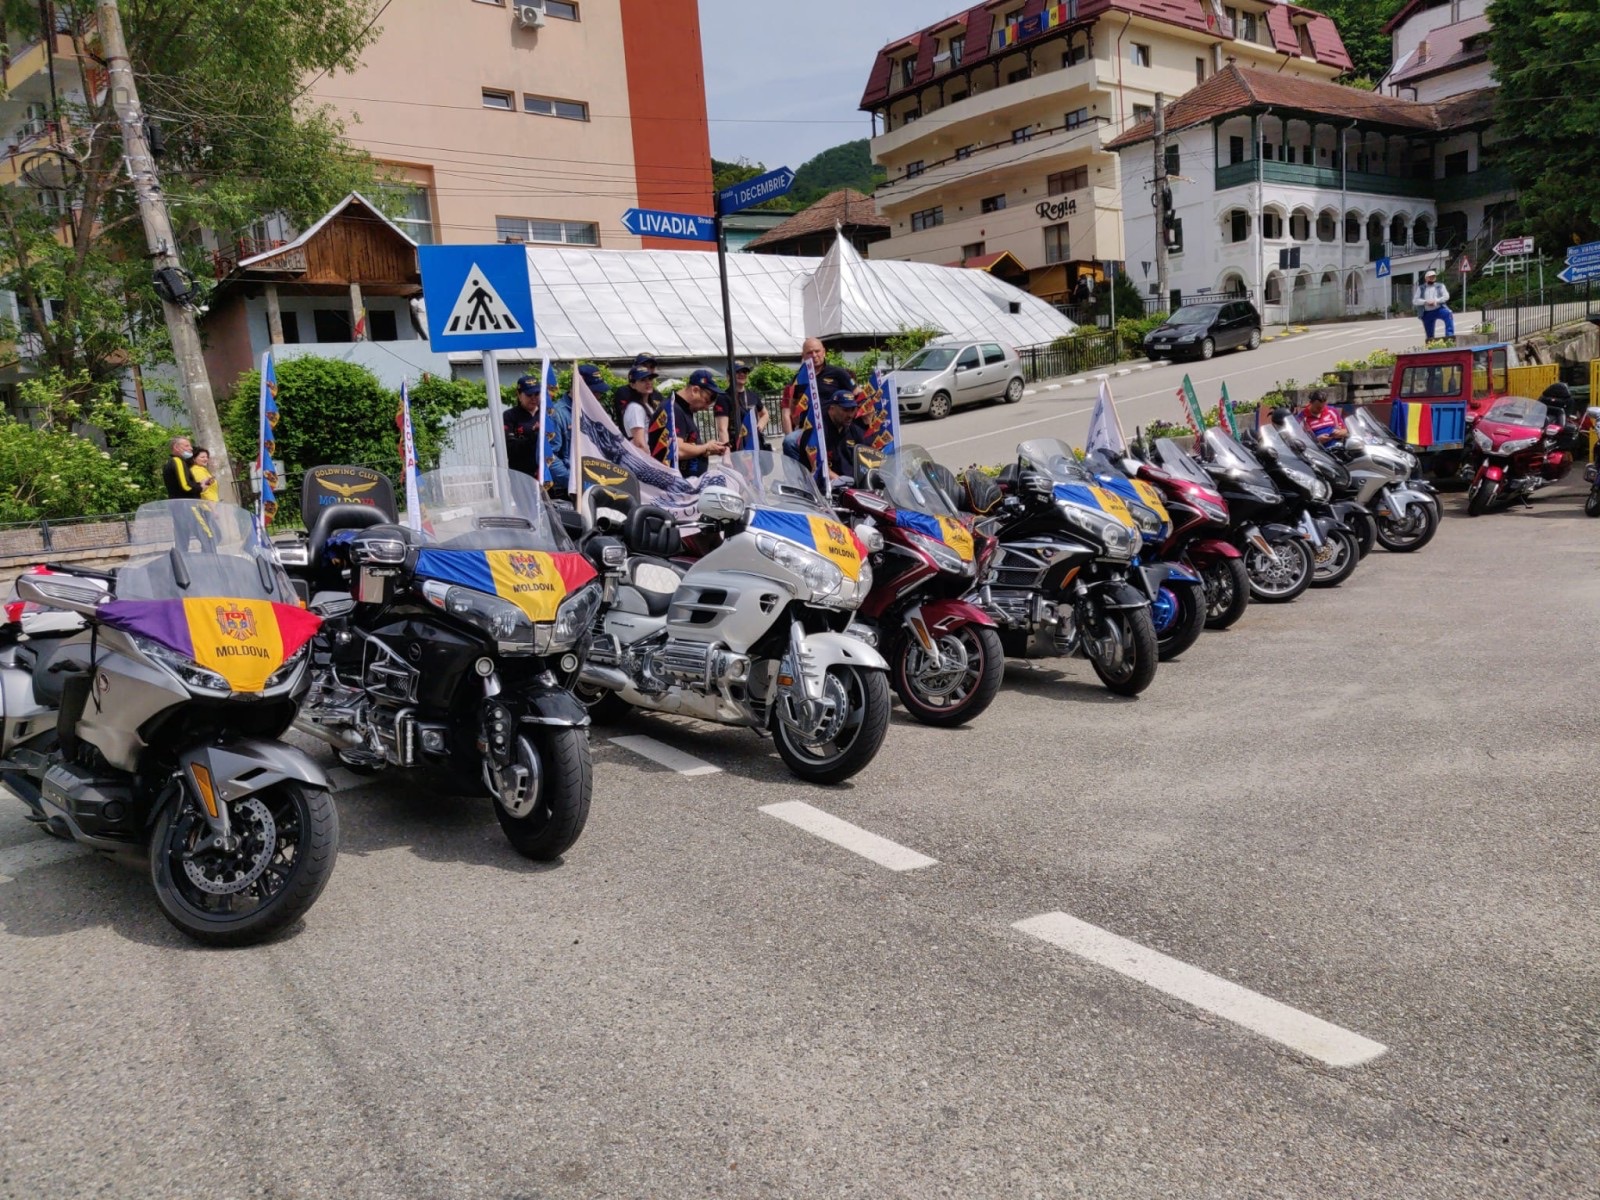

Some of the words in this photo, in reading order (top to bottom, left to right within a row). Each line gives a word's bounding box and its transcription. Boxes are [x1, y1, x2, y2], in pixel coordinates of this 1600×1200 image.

[734, 193, 739, 206] 1
[740, 174, 787, 204] DECEMBRIE
[1035, 196, 1077, 221] Regia
[639, 212, 699, 236] LIVADIA
[806, 361, 823, 431] MOLDOVA
[315, 468, 355, 478] GOLDWING
[358, 470, 379, 481] CLUB
[828, 546, 856, 560] MOLDOVA
[513, 582, 556, 593] MOLDOVA
[215, 645, 271, 660] MOLDOVA
